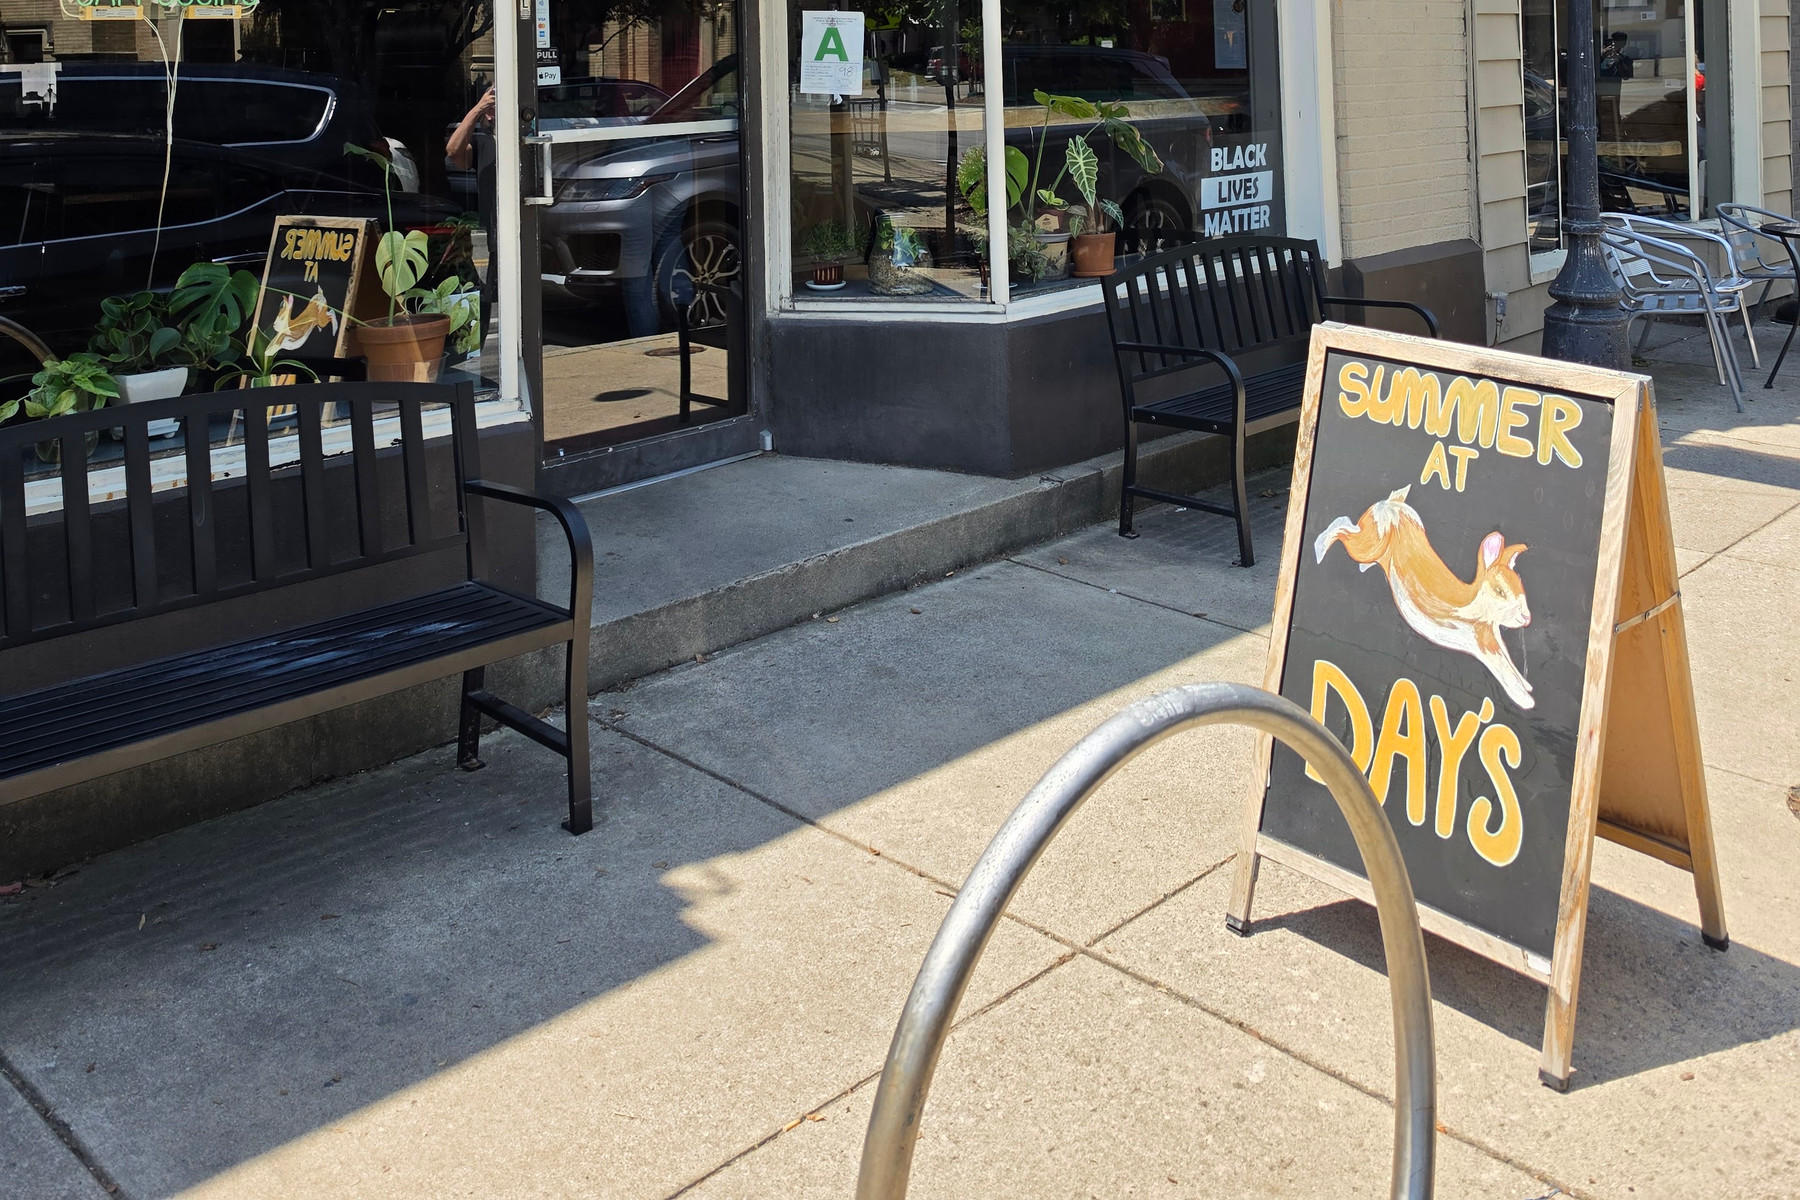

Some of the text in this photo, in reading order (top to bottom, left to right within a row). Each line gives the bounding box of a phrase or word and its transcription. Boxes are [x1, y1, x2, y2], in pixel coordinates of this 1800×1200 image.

[537, 51, 557, 59] PULL
[814, 27, 849, 61] A
[544, 72, 557, 80] Pay
[839, 66, 853, 78] 98
[1210, 143, 1267, 172] BLACK
[1218, 176, 1259, 204] LIVES
[1204, 204, 1271, 238] MATTER
[1338, 362, 1583, 468] SUMMER
[1420, 441, 1479, 492] AT
[1305, 659, 1524, 867] DAY'S
